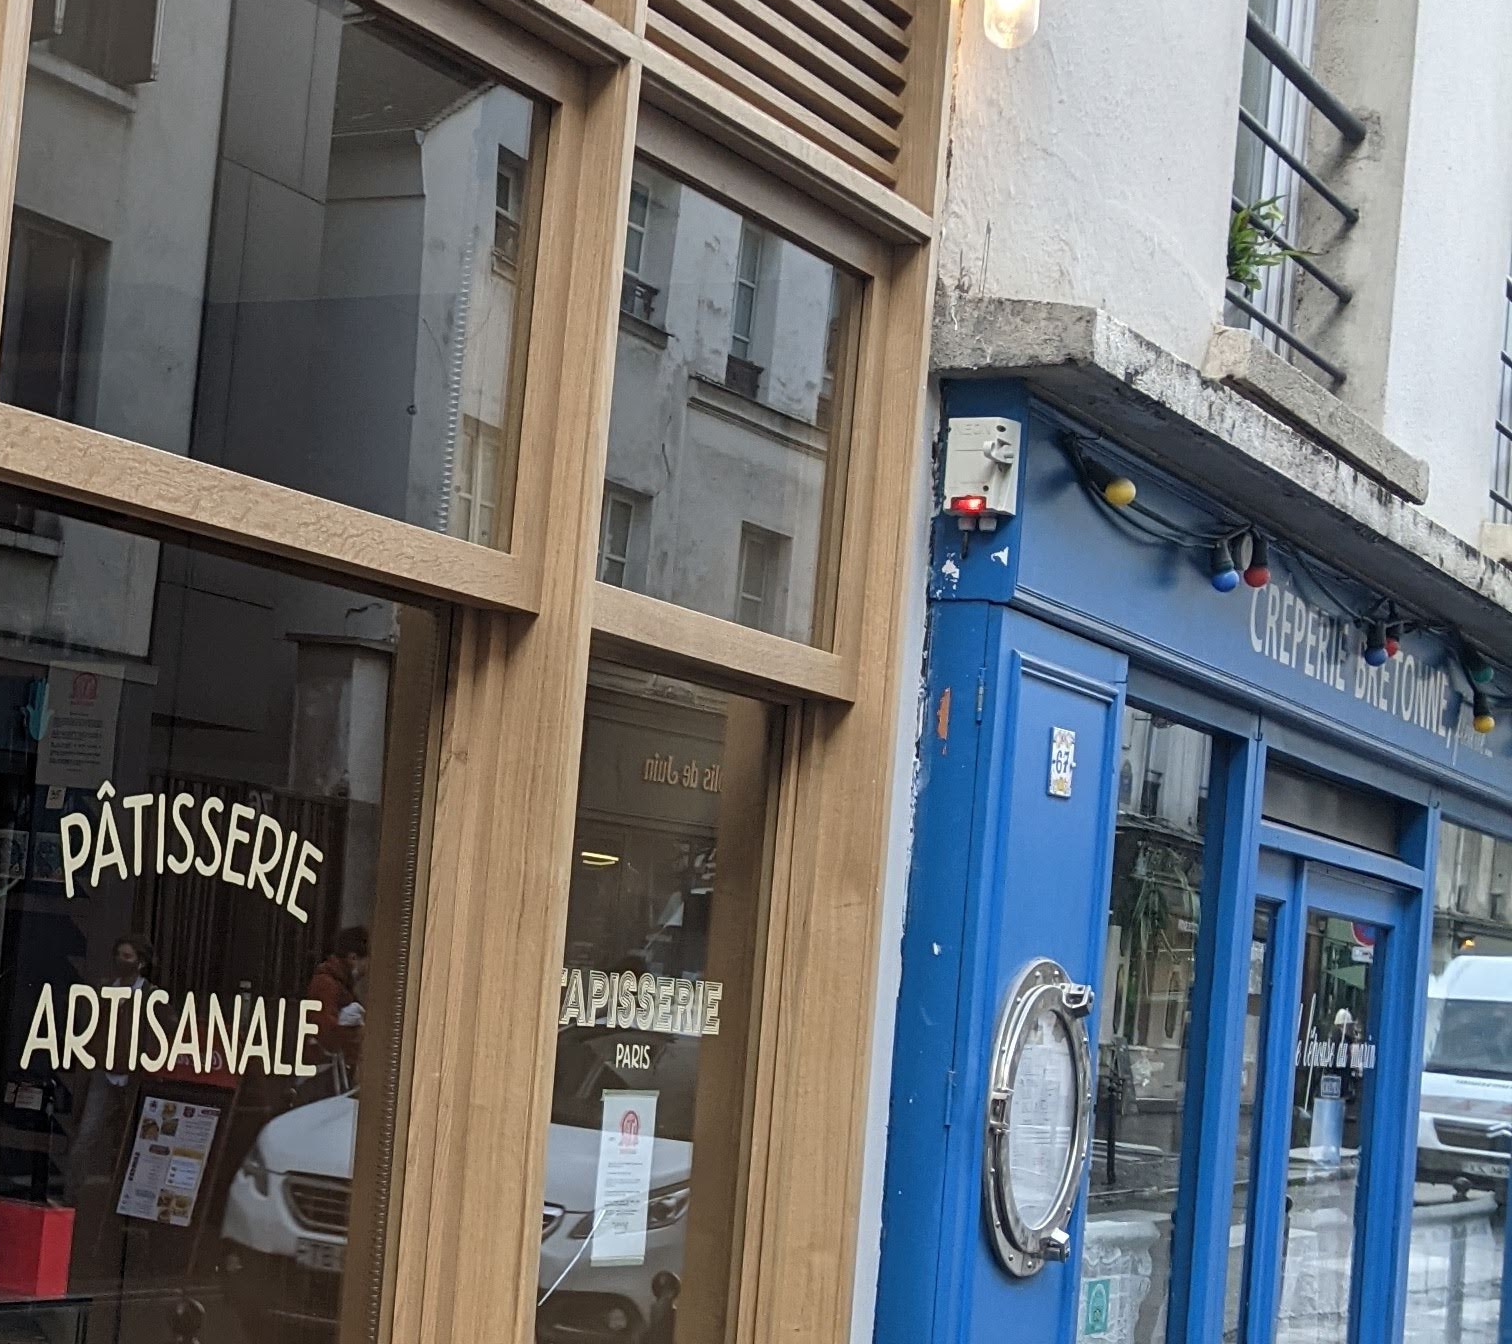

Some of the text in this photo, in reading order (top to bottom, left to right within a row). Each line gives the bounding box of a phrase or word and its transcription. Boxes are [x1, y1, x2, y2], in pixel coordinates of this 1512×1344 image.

[1055, 749, 1070, 774] 67
[60, 780, 324, 924] PÂTISSERIE
[20, 982, 324, 1078] ARTISANALE
[615, 1043, 651, 1070] PARIS
